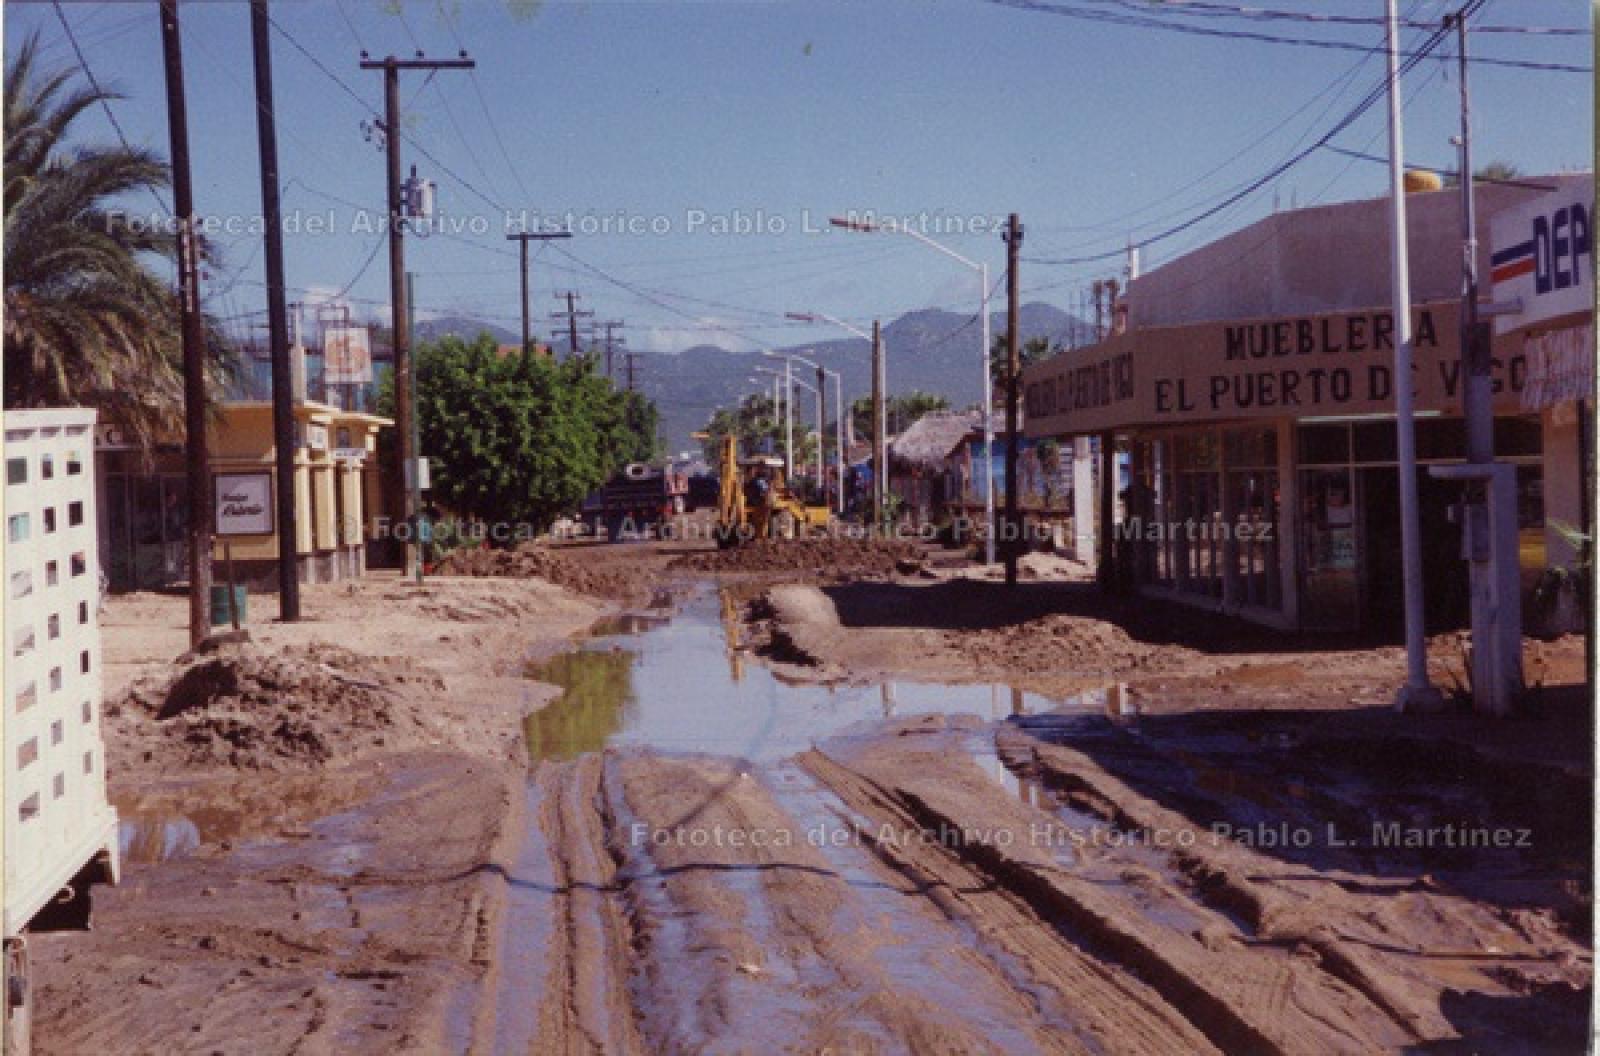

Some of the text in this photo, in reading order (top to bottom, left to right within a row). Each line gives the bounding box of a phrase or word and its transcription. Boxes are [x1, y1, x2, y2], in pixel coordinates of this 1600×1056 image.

[1226, 311, 1438, 360] MUEBLERA
[1154, 378, 1194, 413] EL
[1210, 367, 1351, 409] PUERTO
